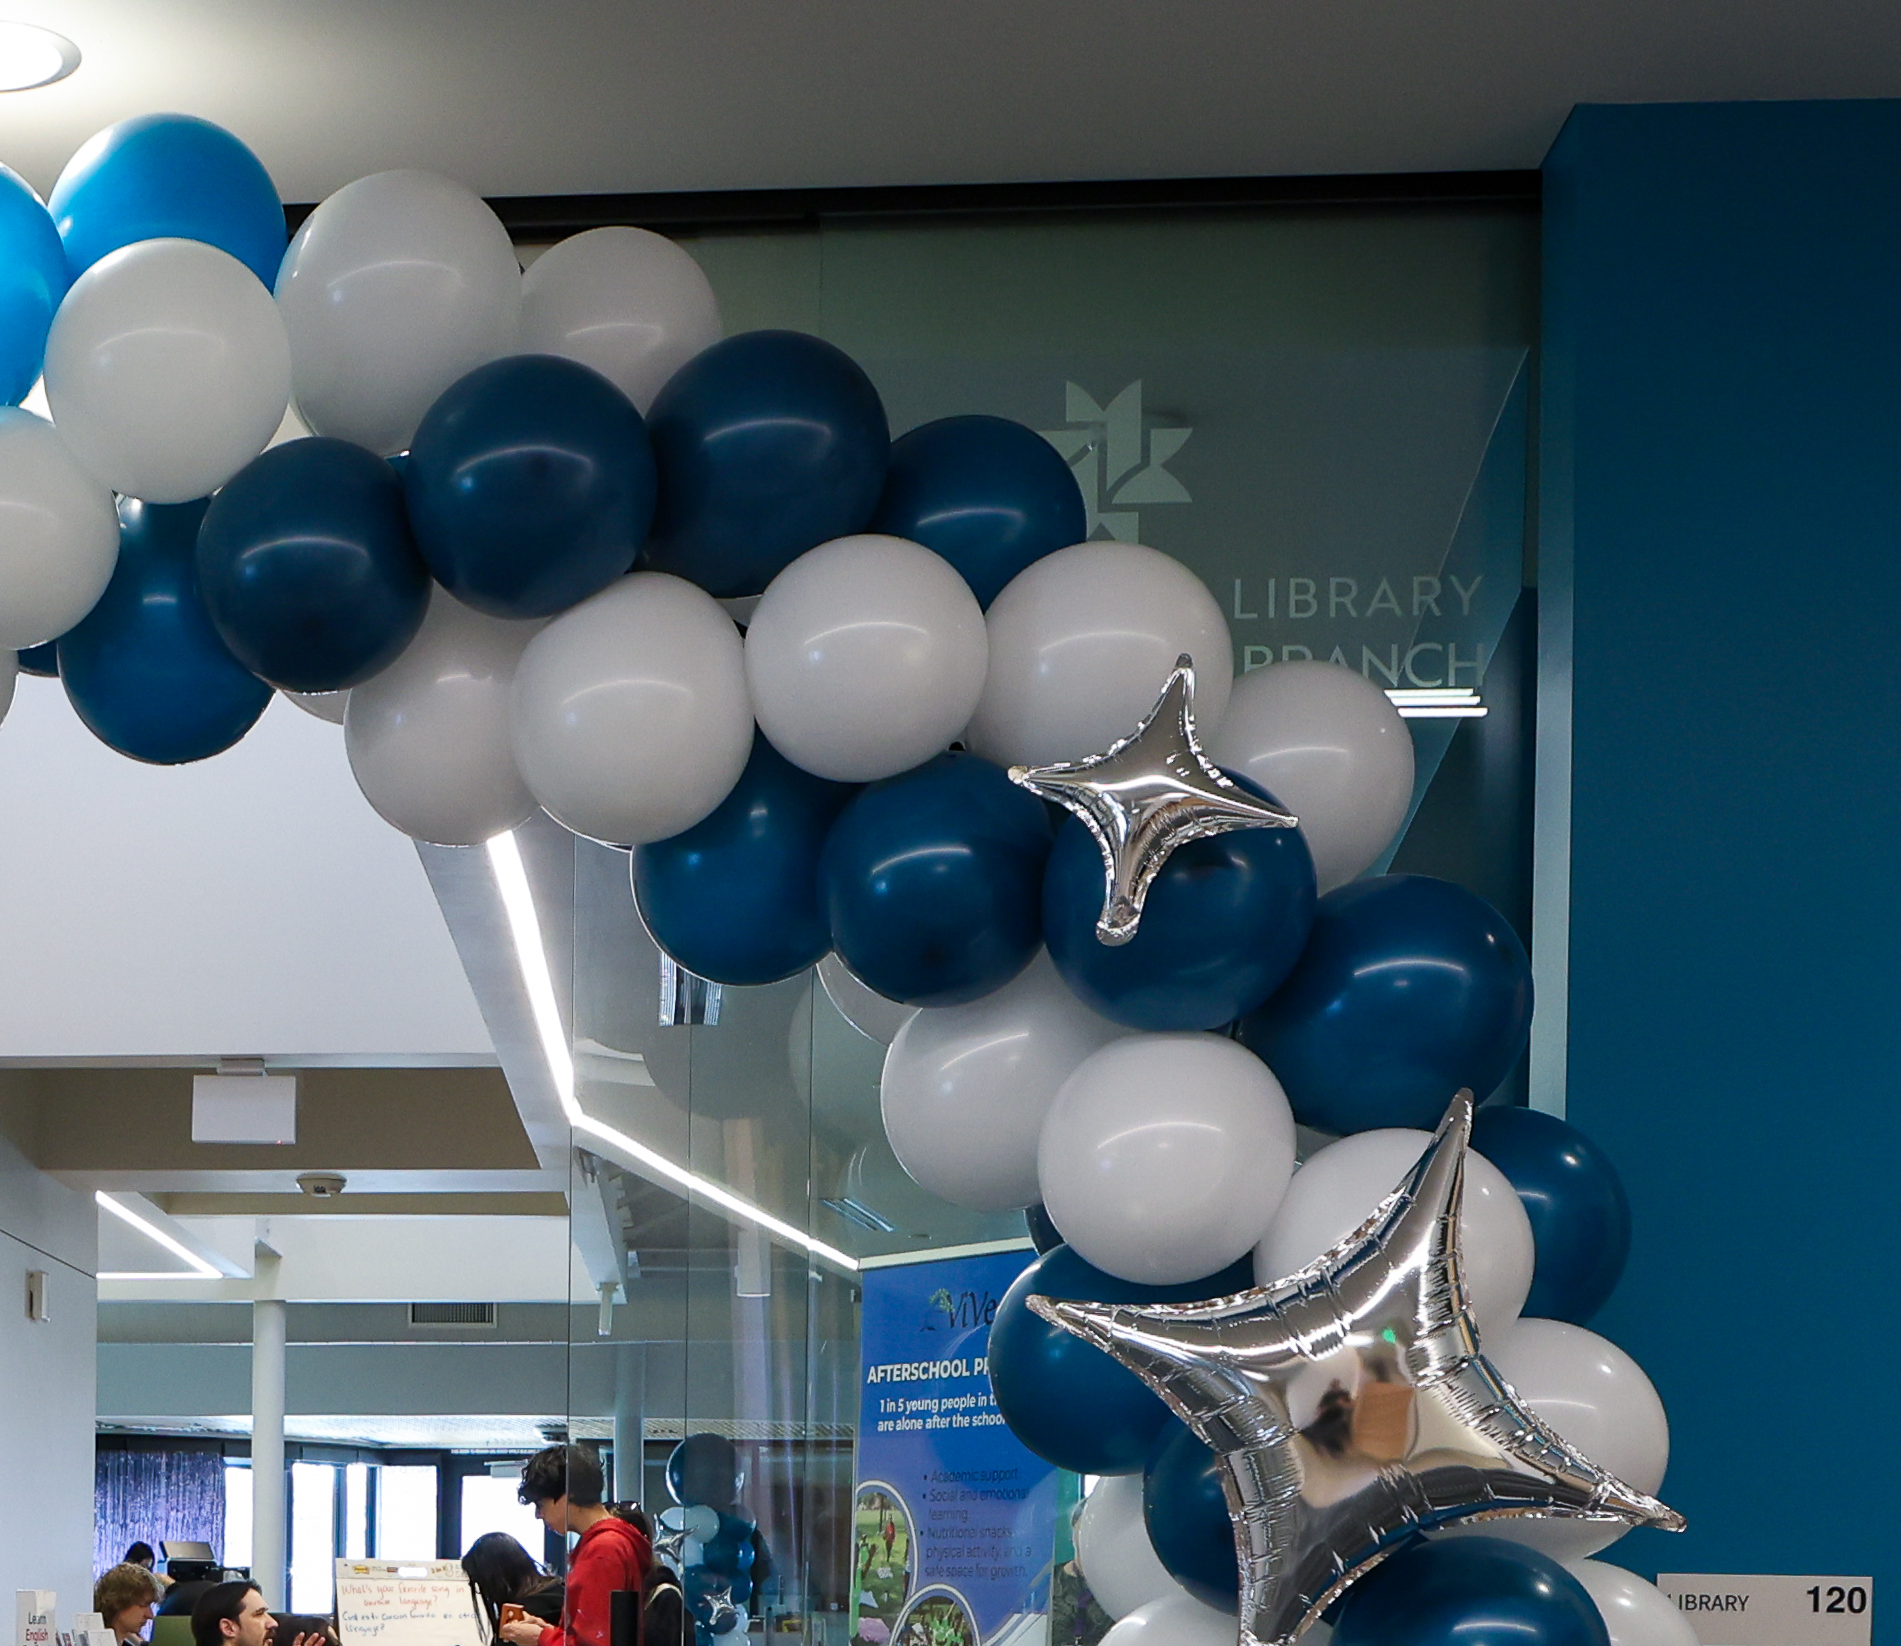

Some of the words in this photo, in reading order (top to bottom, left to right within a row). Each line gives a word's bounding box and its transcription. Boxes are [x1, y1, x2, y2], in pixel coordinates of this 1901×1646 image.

[1234, 575, 1484, 619] LIBRARY
[866, 1358, 971, 1384] AFTERSCHOOL
[879, 1399, 885, 1413] 1
[886, 1398, 896, 1412] in
[897, 1398, 904, 1412] 5
[905, 1398, 939, 1414] young
[940, 1393, 975, 1412] people
[977, 1392, 987, 1406] in
[877, 1420, 894, 1432] are
[895, 1416, 923, 1431] alone
[925, 1413, 950, 1429] after
[952, 1412, 970, 1427] the
[930, 1469, 978, 1483] Academic
[980, 1467, 1018, 1484] support
[929, 1489, 958, 1502] Social
[980, 1486, 1029, 1501] emotional
[929, 1508, 968, 1523] learning
[926, 1545, 965, 1561] physical
[925, 1564, 944, 1577] safe
[946, 1566, 973, 1579] space
[976, 1563, 988, 1577] for
[342, 1583, 372, 1595] What's
[377, 1585, 394, 1600] your
[398, 1581, 427, 1594] favorite
[431, 1585, 449, 1597] song
[364, 1598, 390, 1606] another
[399, 1595, 437, 1610] language?
[1667, 1593, 1749, 1611] IBRARY
[1807, 1586, 1867, 1613] 120
[28, 1612, 47, 1624] Learn
[26, 1628, 48, 1644] English
